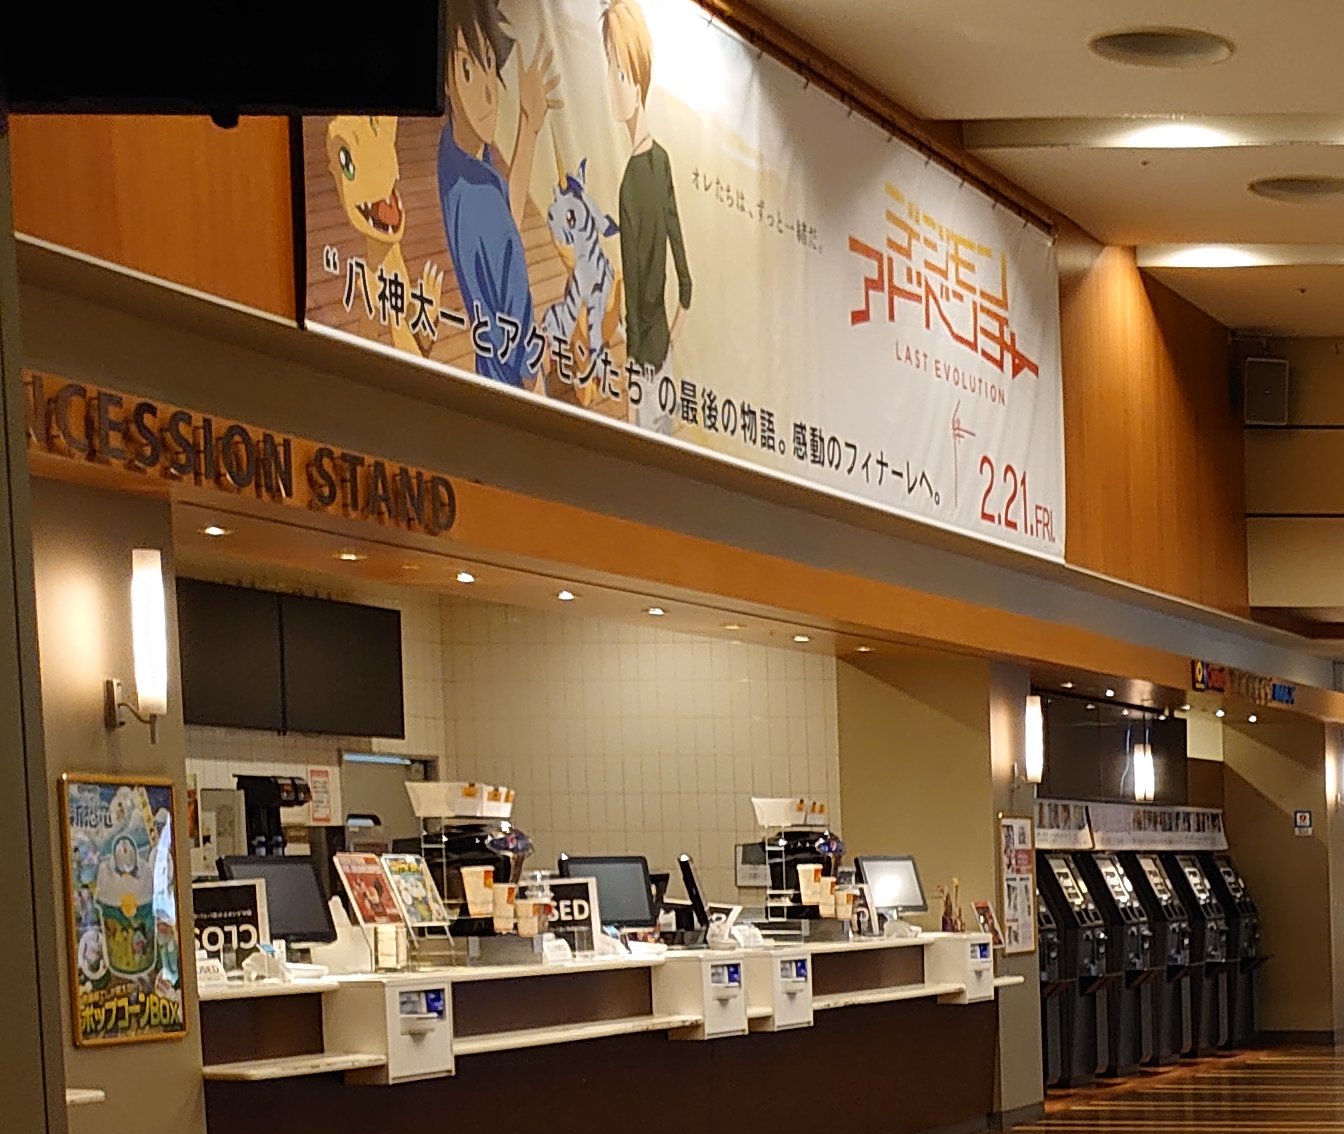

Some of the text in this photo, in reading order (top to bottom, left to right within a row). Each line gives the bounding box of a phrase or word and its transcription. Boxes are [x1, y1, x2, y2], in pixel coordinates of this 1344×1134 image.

[692, 167, 823, 254] オレたちは、ずっと一緒だ。
[885, 181, 1008, 311] デジモン
[894, 340, 1006, 406] LAST EVOLUTION
[313, 446, 457, 533] STAND
